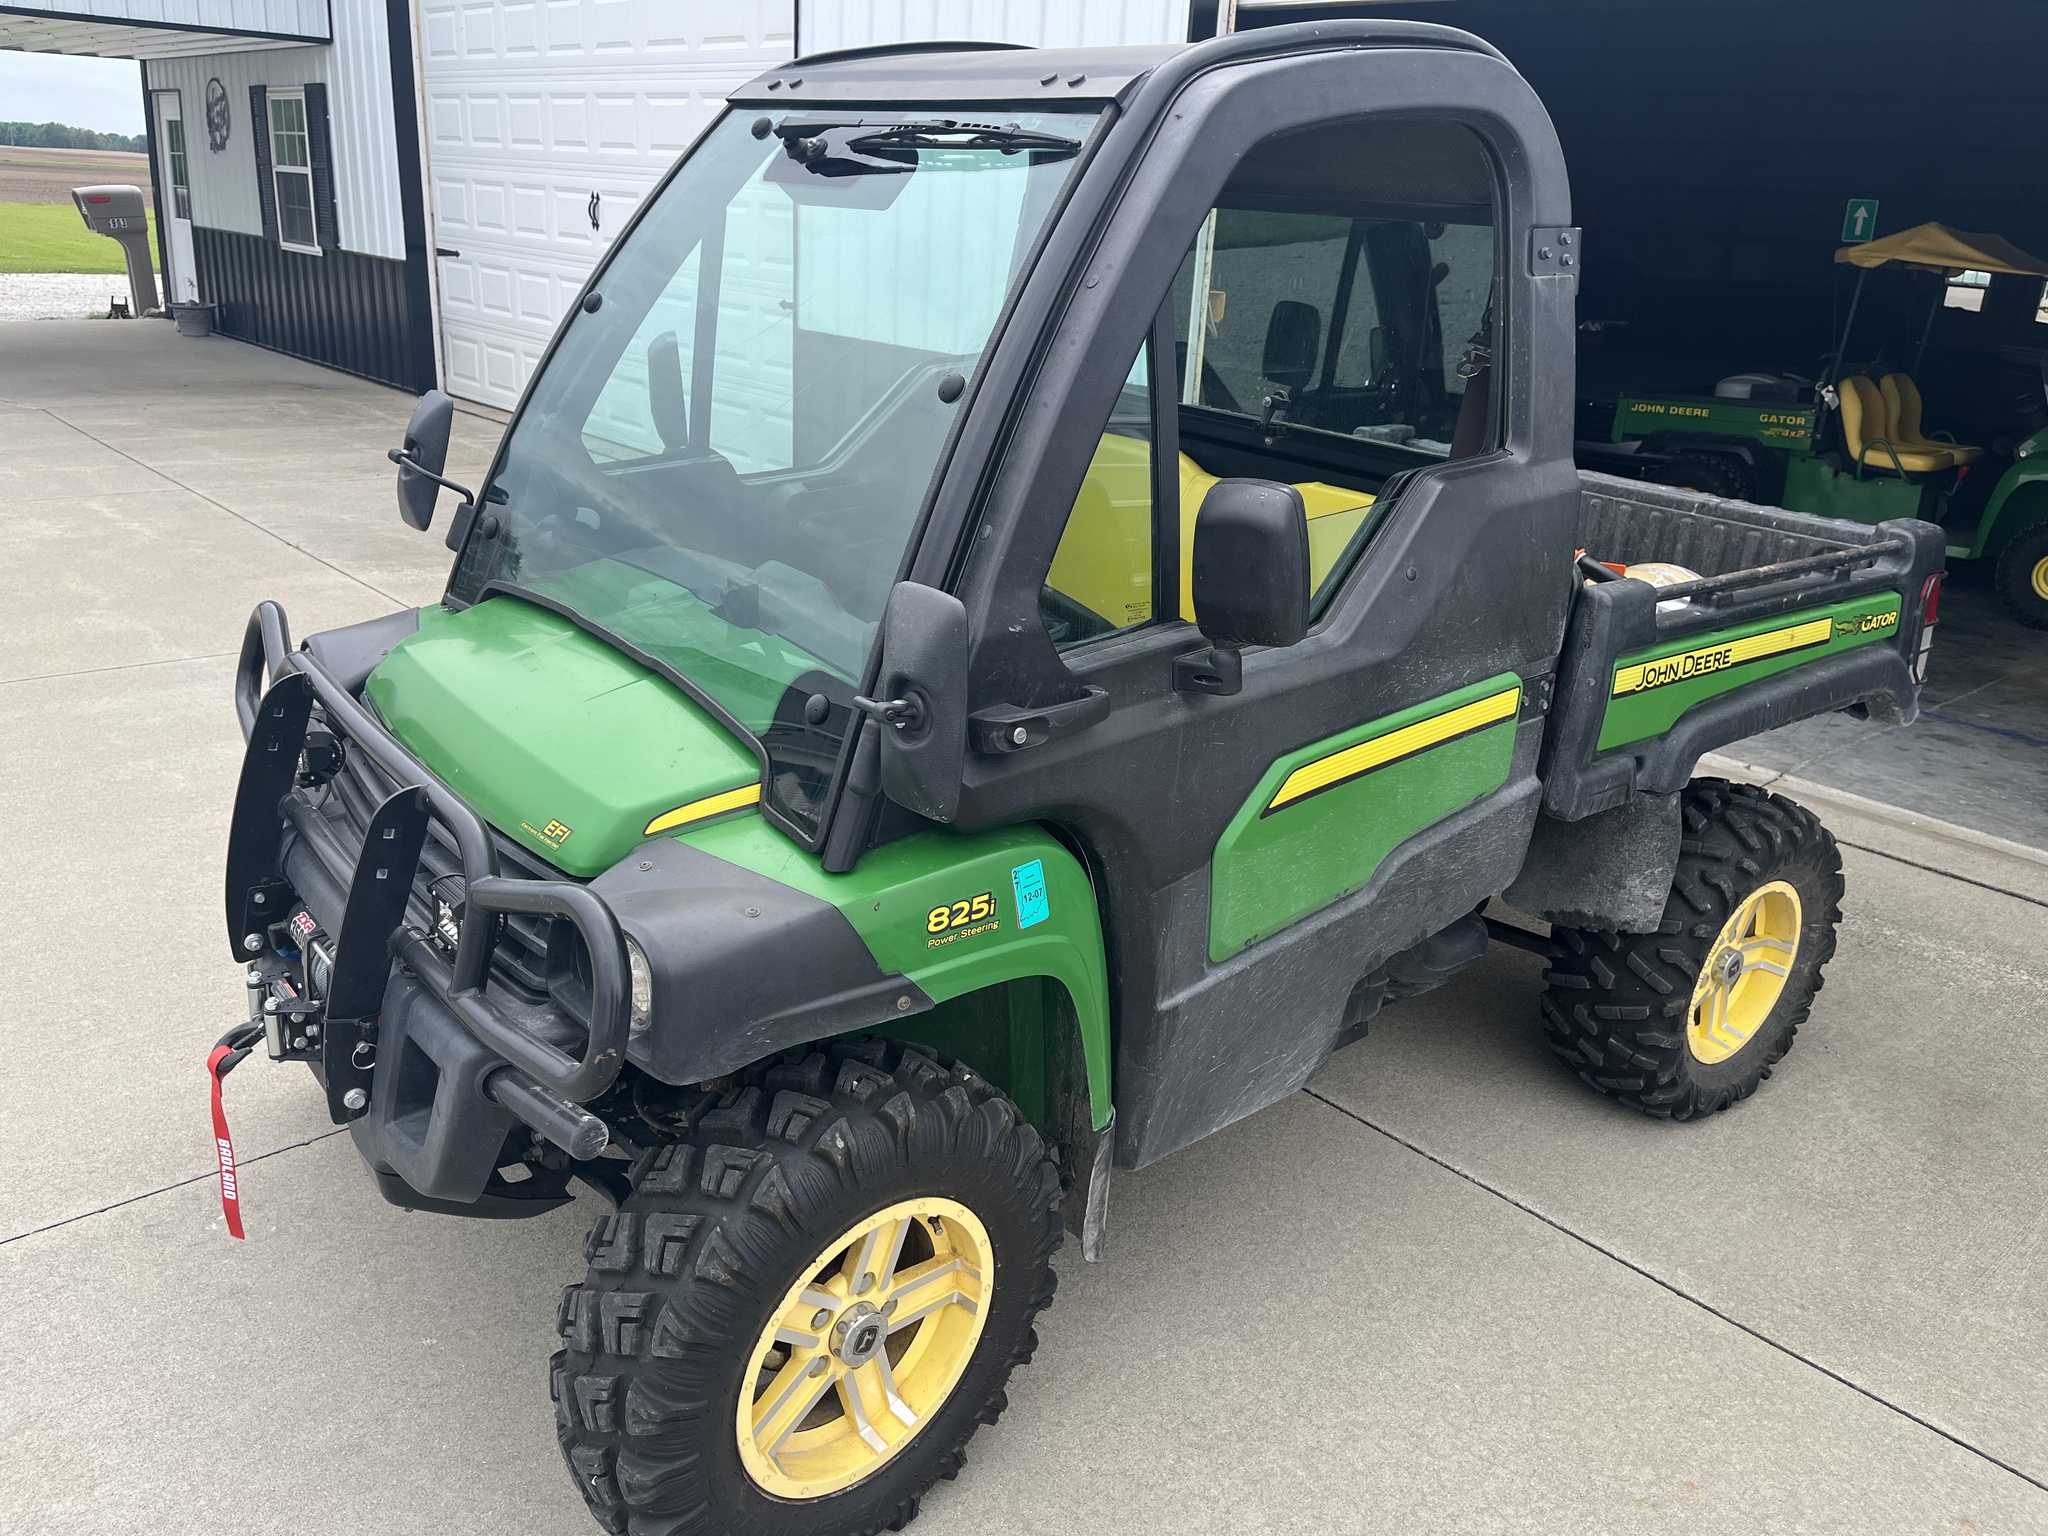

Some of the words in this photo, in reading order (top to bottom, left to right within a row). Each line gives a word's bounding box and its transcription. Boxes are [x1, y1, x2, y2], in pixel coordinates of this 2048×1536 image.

[1631, 403, 1665, 414] JOHN
[1669, 405, 1710, 418] DEERE
[1759, 413, 1806, 426] GATOR
[1861, 611, 1898, 632] GATOR
[1636, 661, 1679, 688] JOHN
[1682, 648, 1733, 676] DEERE
[541, 818, 572, 844] EFI
[1023, 887, 1043, 903] 12-07
[296, 911, 316, 933] ZXR
[926, 892, 996, 934] 825i
[291, 919, 306, 949] 350
[927, 933, 958, 949] Power
[960, 921, 999, 939] Steering
[217, 1138, 236, 1200] BADLAND
